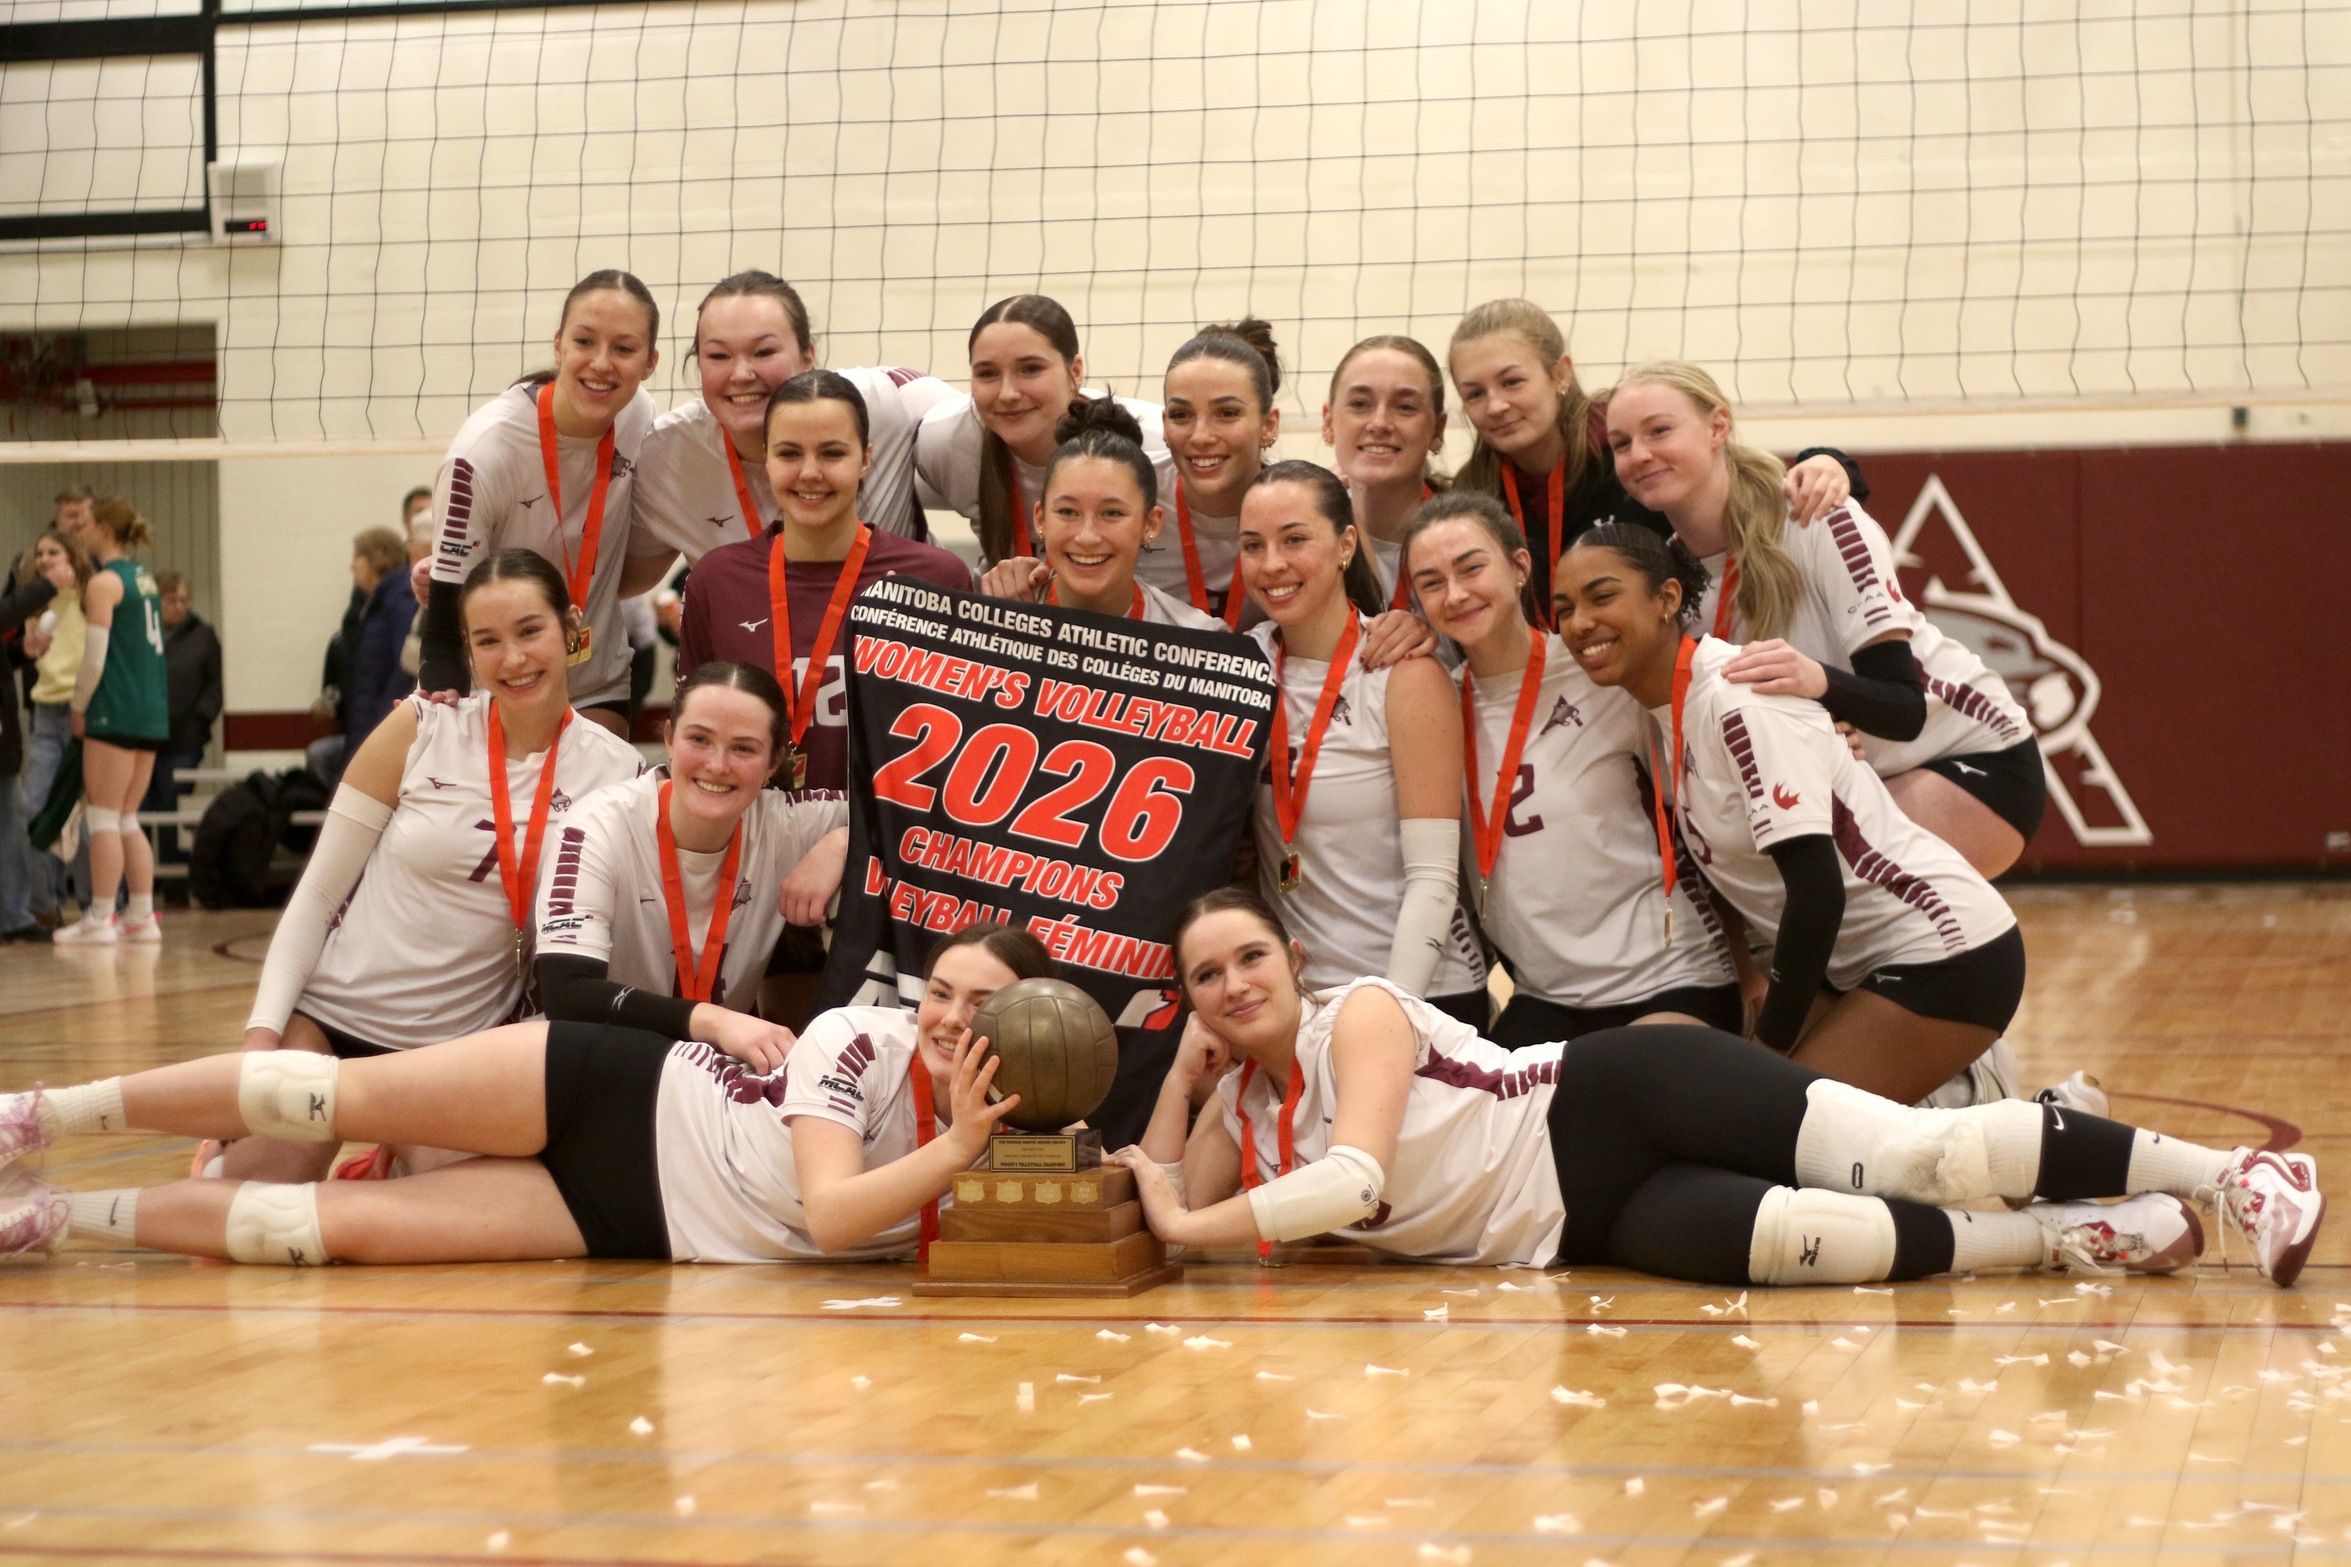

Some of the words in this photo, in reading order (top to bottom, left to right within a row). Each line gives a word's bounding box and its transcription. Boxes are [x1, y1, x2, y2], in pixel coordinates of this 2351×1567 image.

[850, 604, 949, 640] CONFÉRENCE
[950, 627, 1044, 662] ATHLÉTIQUE
[1046, 648, 1079, 670] DES
[1162, 672, 1187, 691] DU
[1188, 677, 1272, 712] MANITOBA
[958, 600, 1053, 638] COLLEGES
[1057, 622, 1149, 658] ATHLETIC
[854, 635, 1031, 709] WOMEN'S
[1033, 678, 1258, 760] VOLLEYBALL
[873, 703, 1195, 863] 2026
[467, 818, 518, 883] 7
[899, 826, 1126, 910] CHAMPIONS
